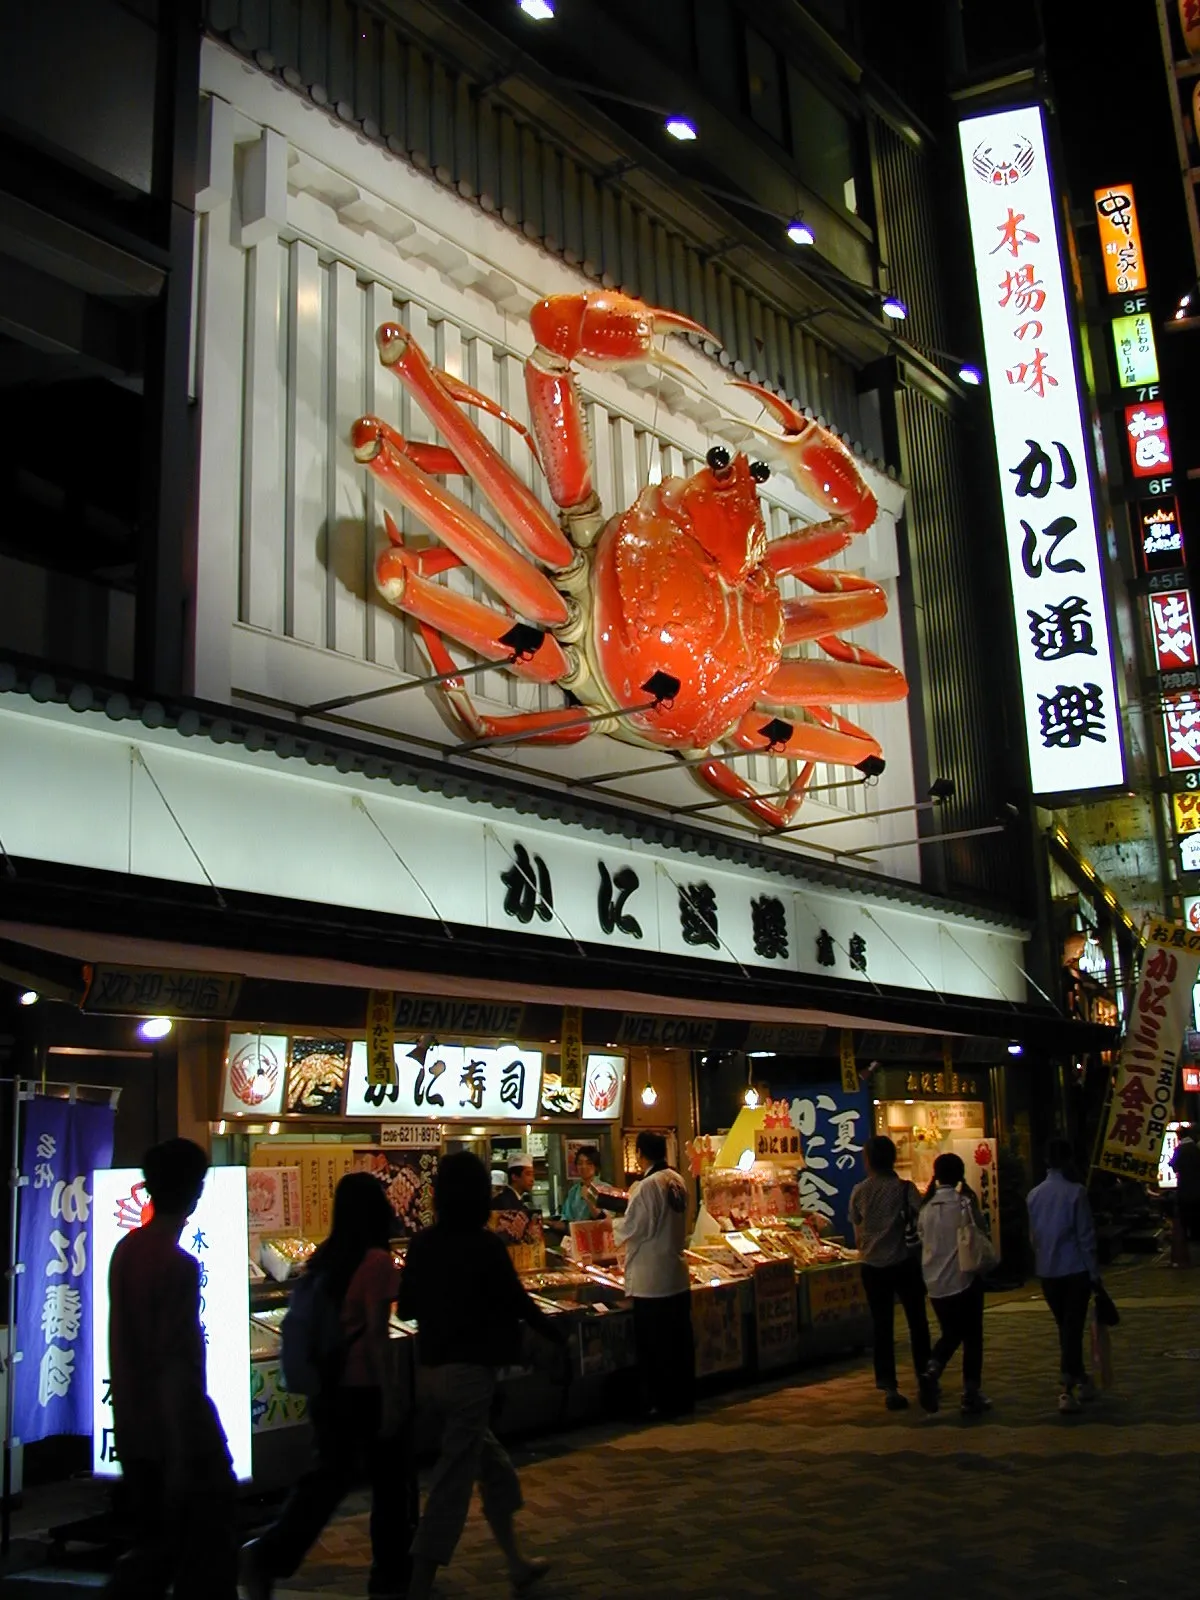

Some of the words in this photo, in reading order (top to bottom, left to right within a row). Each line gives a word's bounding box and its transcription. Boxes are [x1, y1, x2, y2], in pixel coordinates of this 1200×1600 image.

[989, 206, 1060, 398] 本場の味
[1124, 299, 1148, 314] 8F
[1136, 387, 1159, 402] 7F
[1149, 478, 1172, 494] 6F
[397, 998, 520, 1032] BIENVENUE
[623, 1015, 715, 1045] WELCOME
[829, 1109, 862, 1170] 夏の
